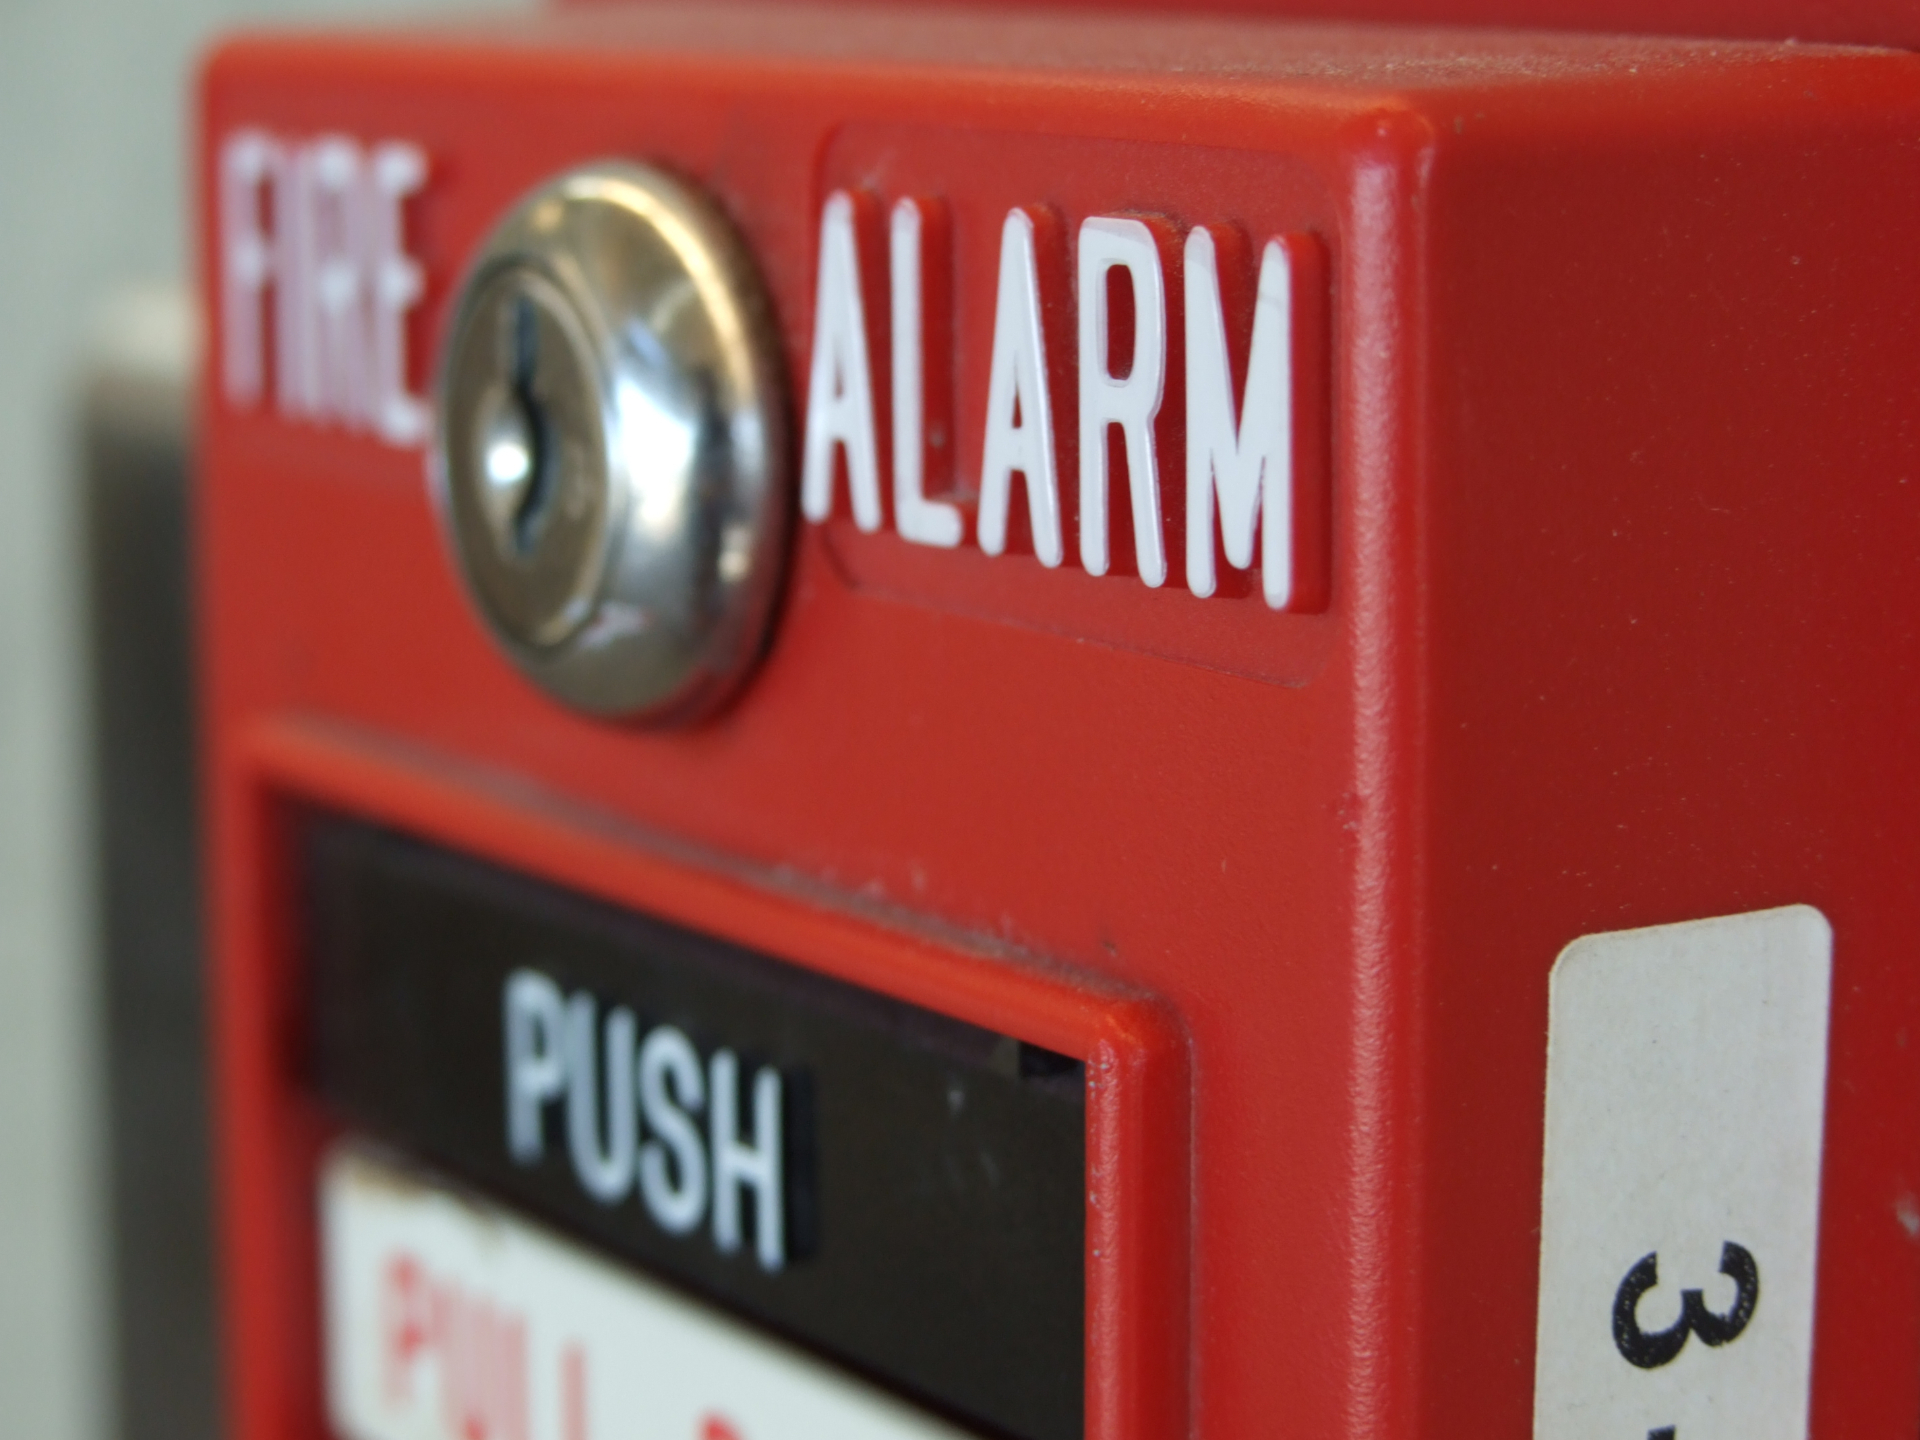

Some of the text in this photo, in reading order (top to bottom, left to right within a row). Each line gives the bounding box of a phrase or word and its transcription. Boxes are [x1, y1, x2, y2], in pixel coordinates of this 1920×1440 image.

[219, 127, 1291, 610] FIRE ALARM
[504, 968, 787, 1274] PUSH
